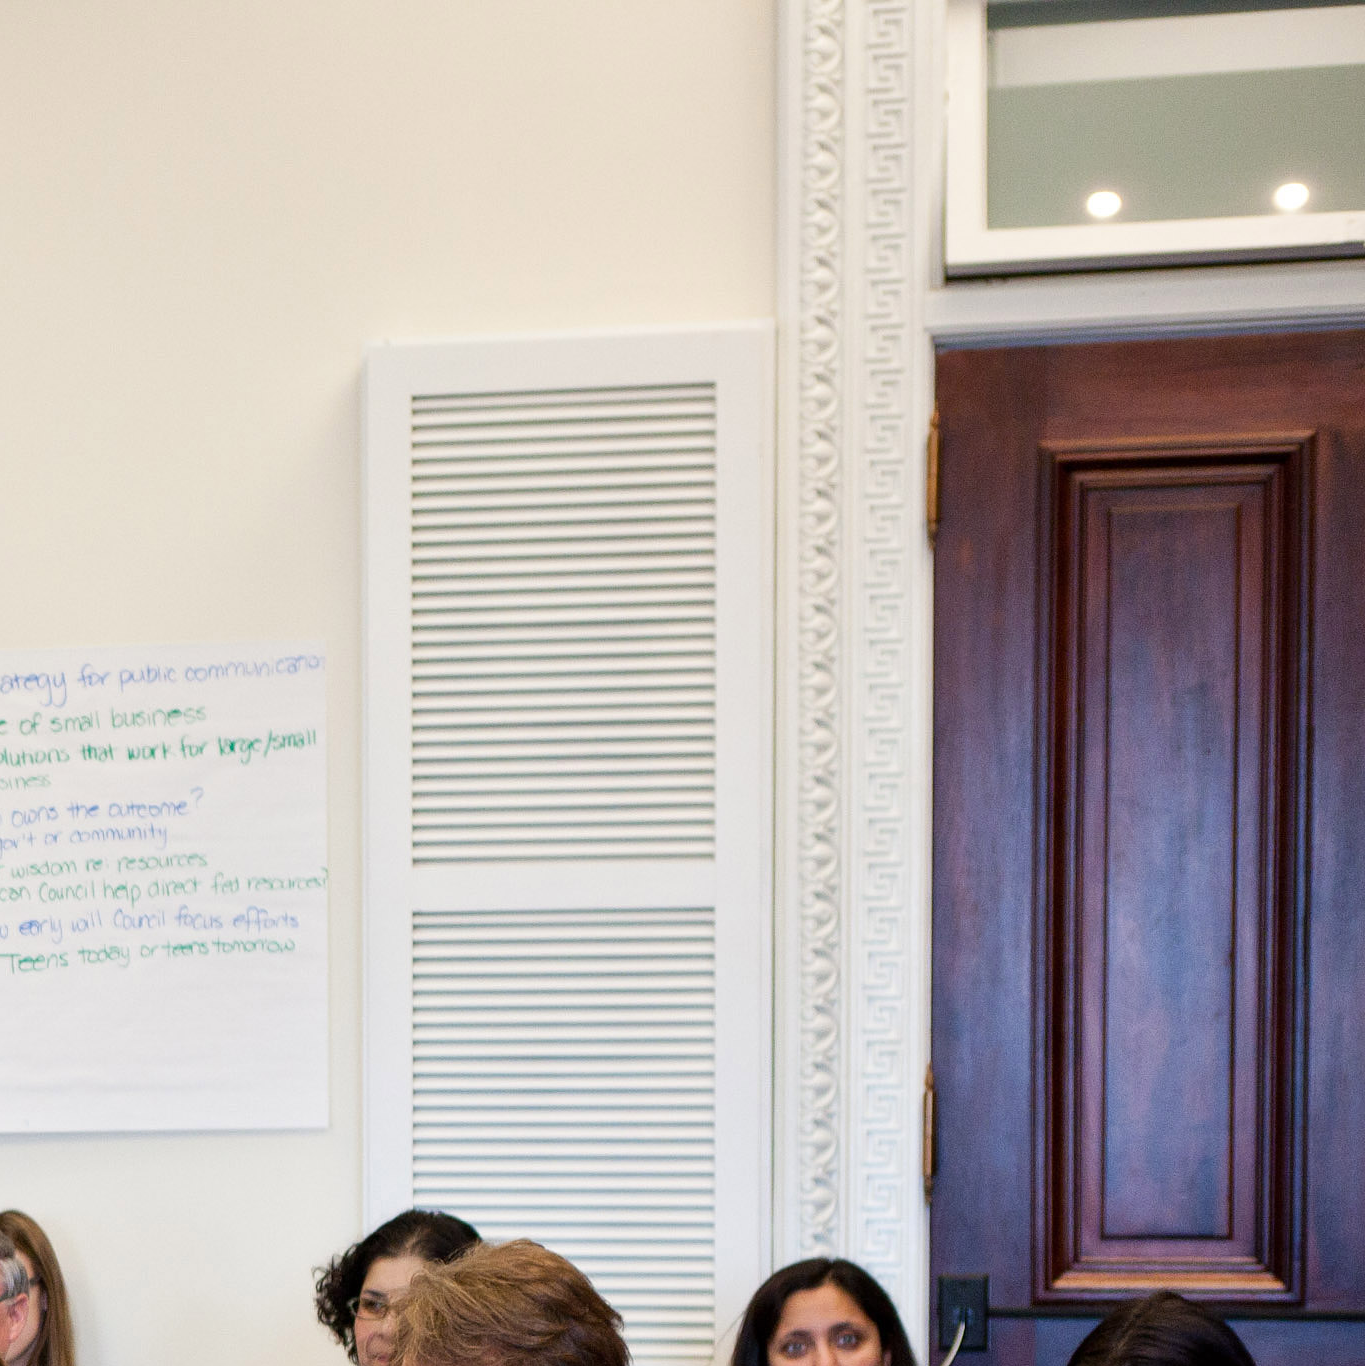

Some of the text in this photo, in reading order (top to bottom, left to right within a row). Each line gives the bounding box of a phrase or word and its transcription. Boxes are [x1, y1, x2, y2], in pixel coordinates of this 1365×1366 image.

[76, 664, 110, 688] for
[119, 665, 177, 693] public
[19, 711, 41, 735] of
[50, 706, 101, 734] small
[111, 704, 208, 729] business
[81, 743, 115, 762] that
[127, 740, 173, 762] work
[179, 735, 208, 758] for
[10, 805, 60, 829] owns
[66, 801, 101, 820] the
[44, 831, 64, 847] or
[69, 823, 170, 854] community
[10, 857, 78, 879] wisdom
[116, 851, 209, 874] resources
[38, 879, 96, 903] Council
[102, 880, 142, 909] help
[148, 874, 202, 897] direct
[18, 916, 65, 944] early
[70, 908, 103, 932] will
[112, 908, 167, 931] Council
[173, 903, 224, 931] focus
[231, 904, 301, 932] efforts
[77, 940, 131, 969] today
[139, 943, 158, 959] or
[166, 939, 210, 958] teens
[211, 936, 296, 955] tomorrow
